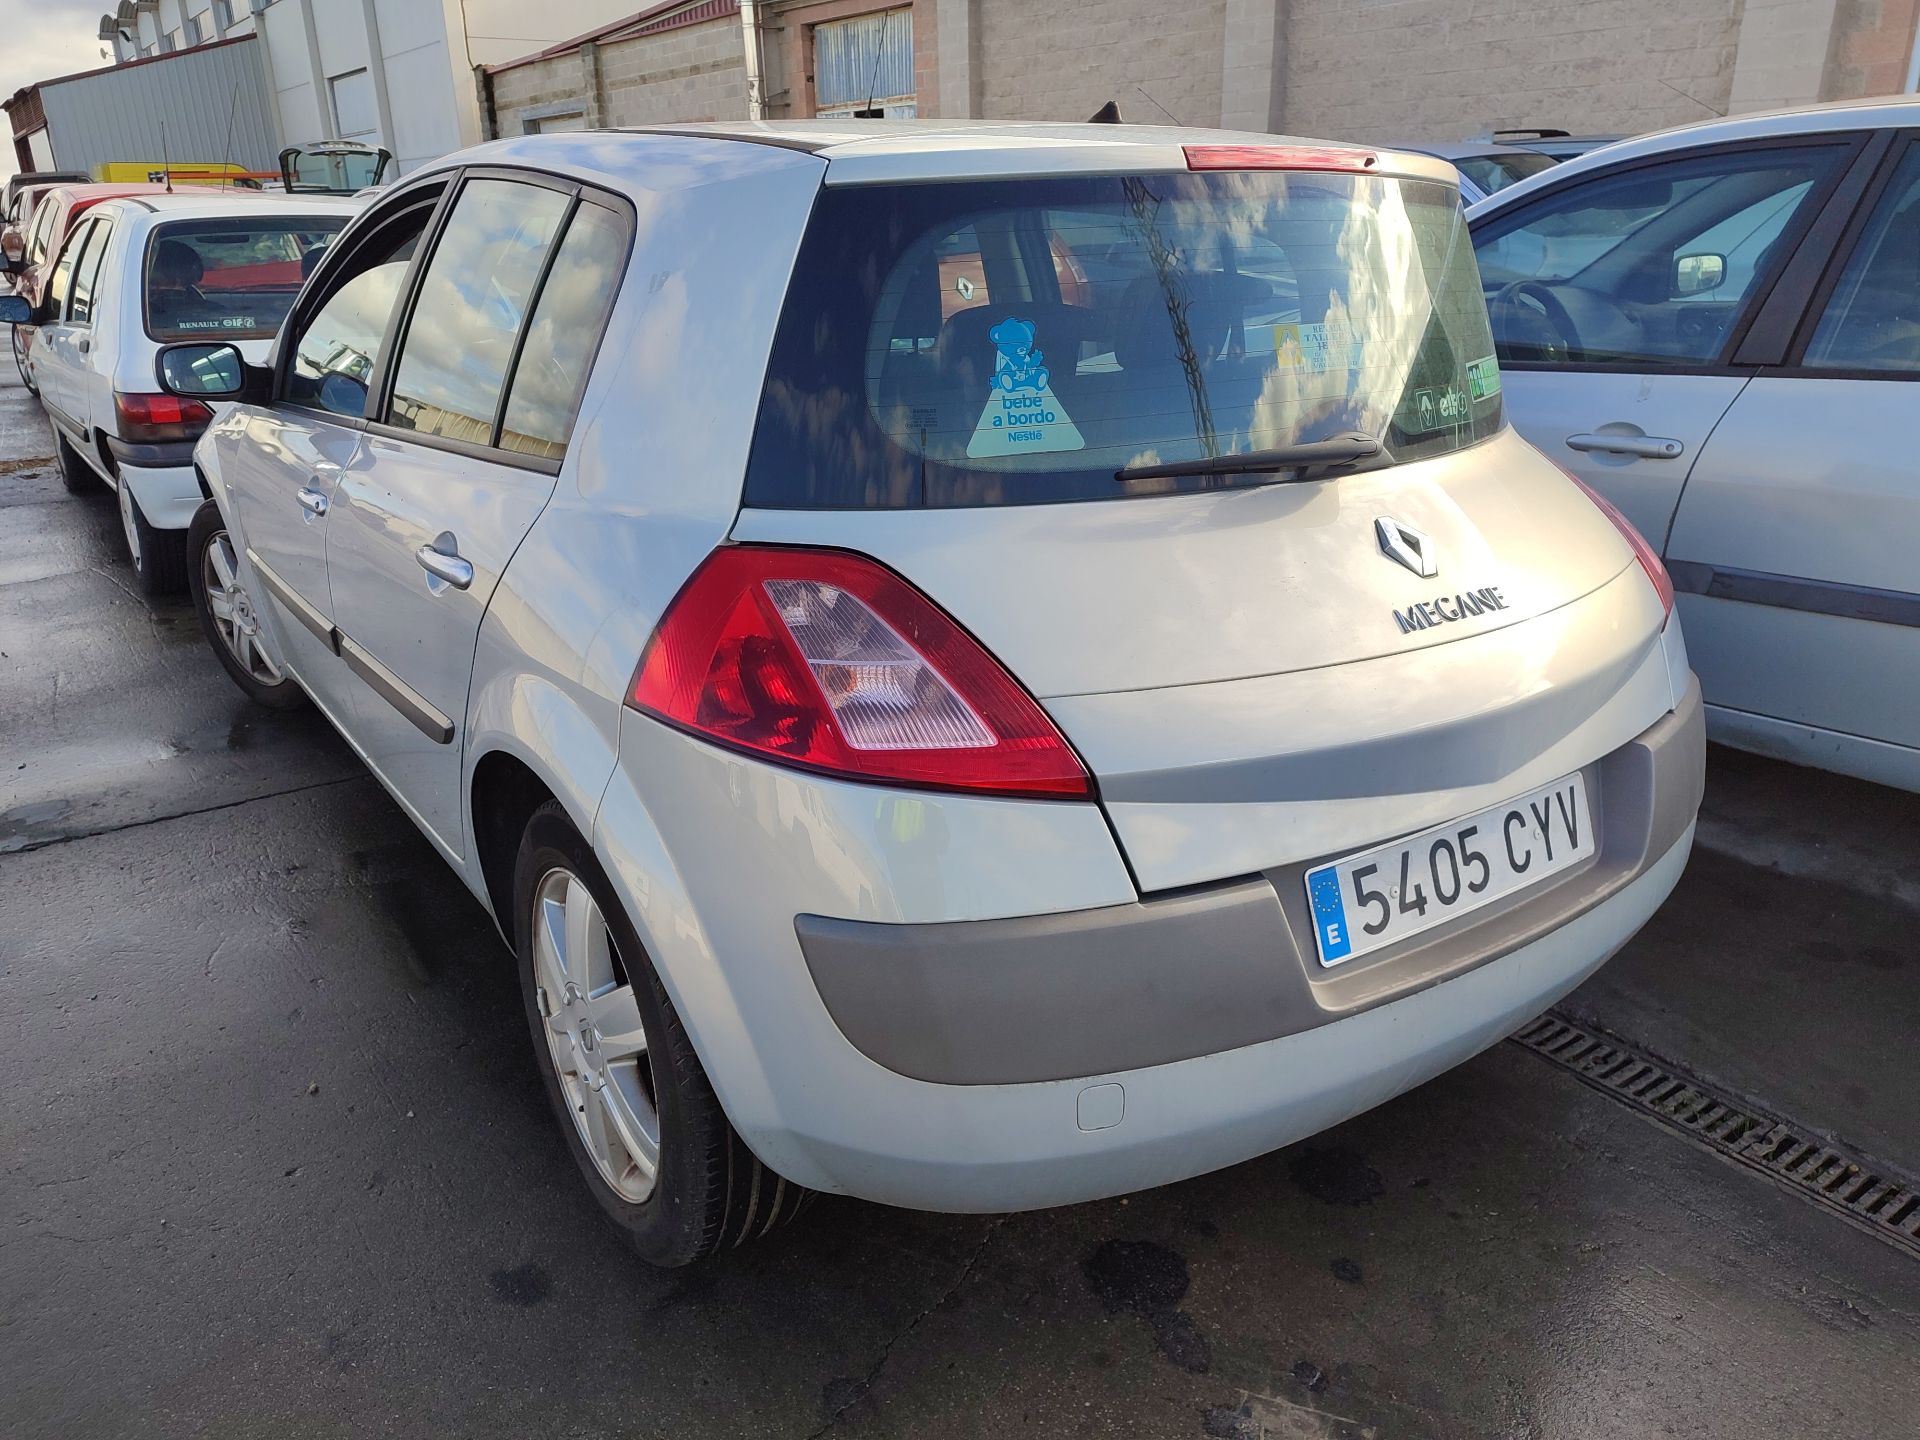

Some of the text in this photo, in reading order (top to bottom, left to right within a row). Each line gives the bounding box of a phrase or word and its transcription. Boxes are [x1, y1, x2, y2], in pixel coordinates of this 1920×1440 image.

[179, 320, 219, 329] RENAULT
[1002, 392, 1043, 410] bebé
[992, 409, 1056, 427] a bordo
[1007, 429, 1043, 442] Nestlé
[1392, 586, 1510, 634] MEGANE
[1351, 784, 1579, 936] 5405 CYV
[1326, 922, 1342, 946] E
